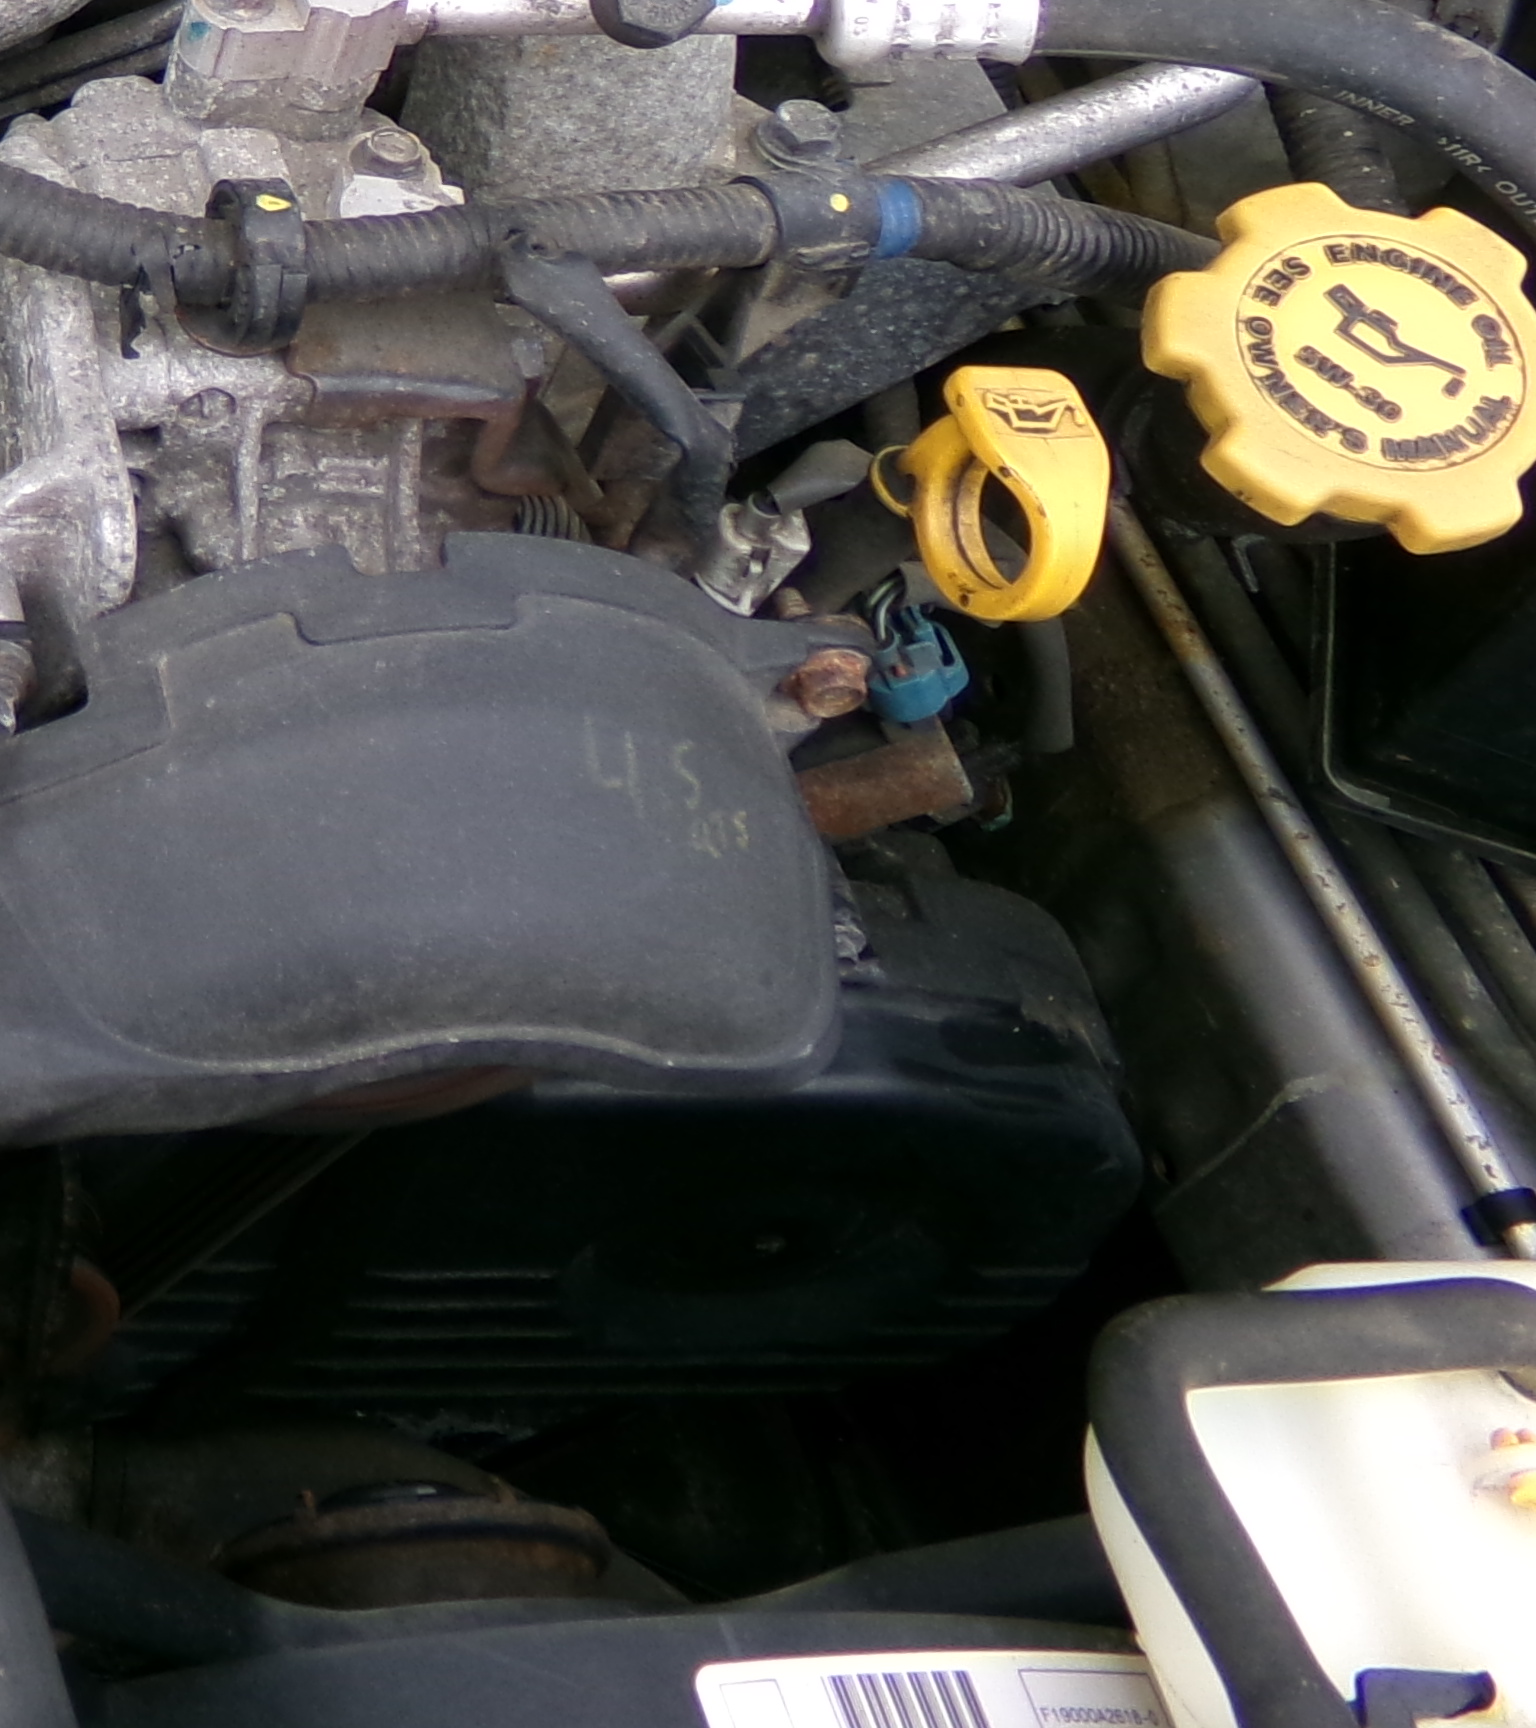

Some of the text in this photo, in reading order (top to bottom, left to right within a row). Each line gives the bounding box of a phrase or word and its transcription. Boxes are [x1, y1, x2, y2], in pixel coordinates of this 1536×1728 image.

[1333, 89, 1416, 126] INNER
[1243, 255, 1514, 463] SEE OWNER'S MANUAL
[1322, 241, 1514, 371] ENGINE OIL
